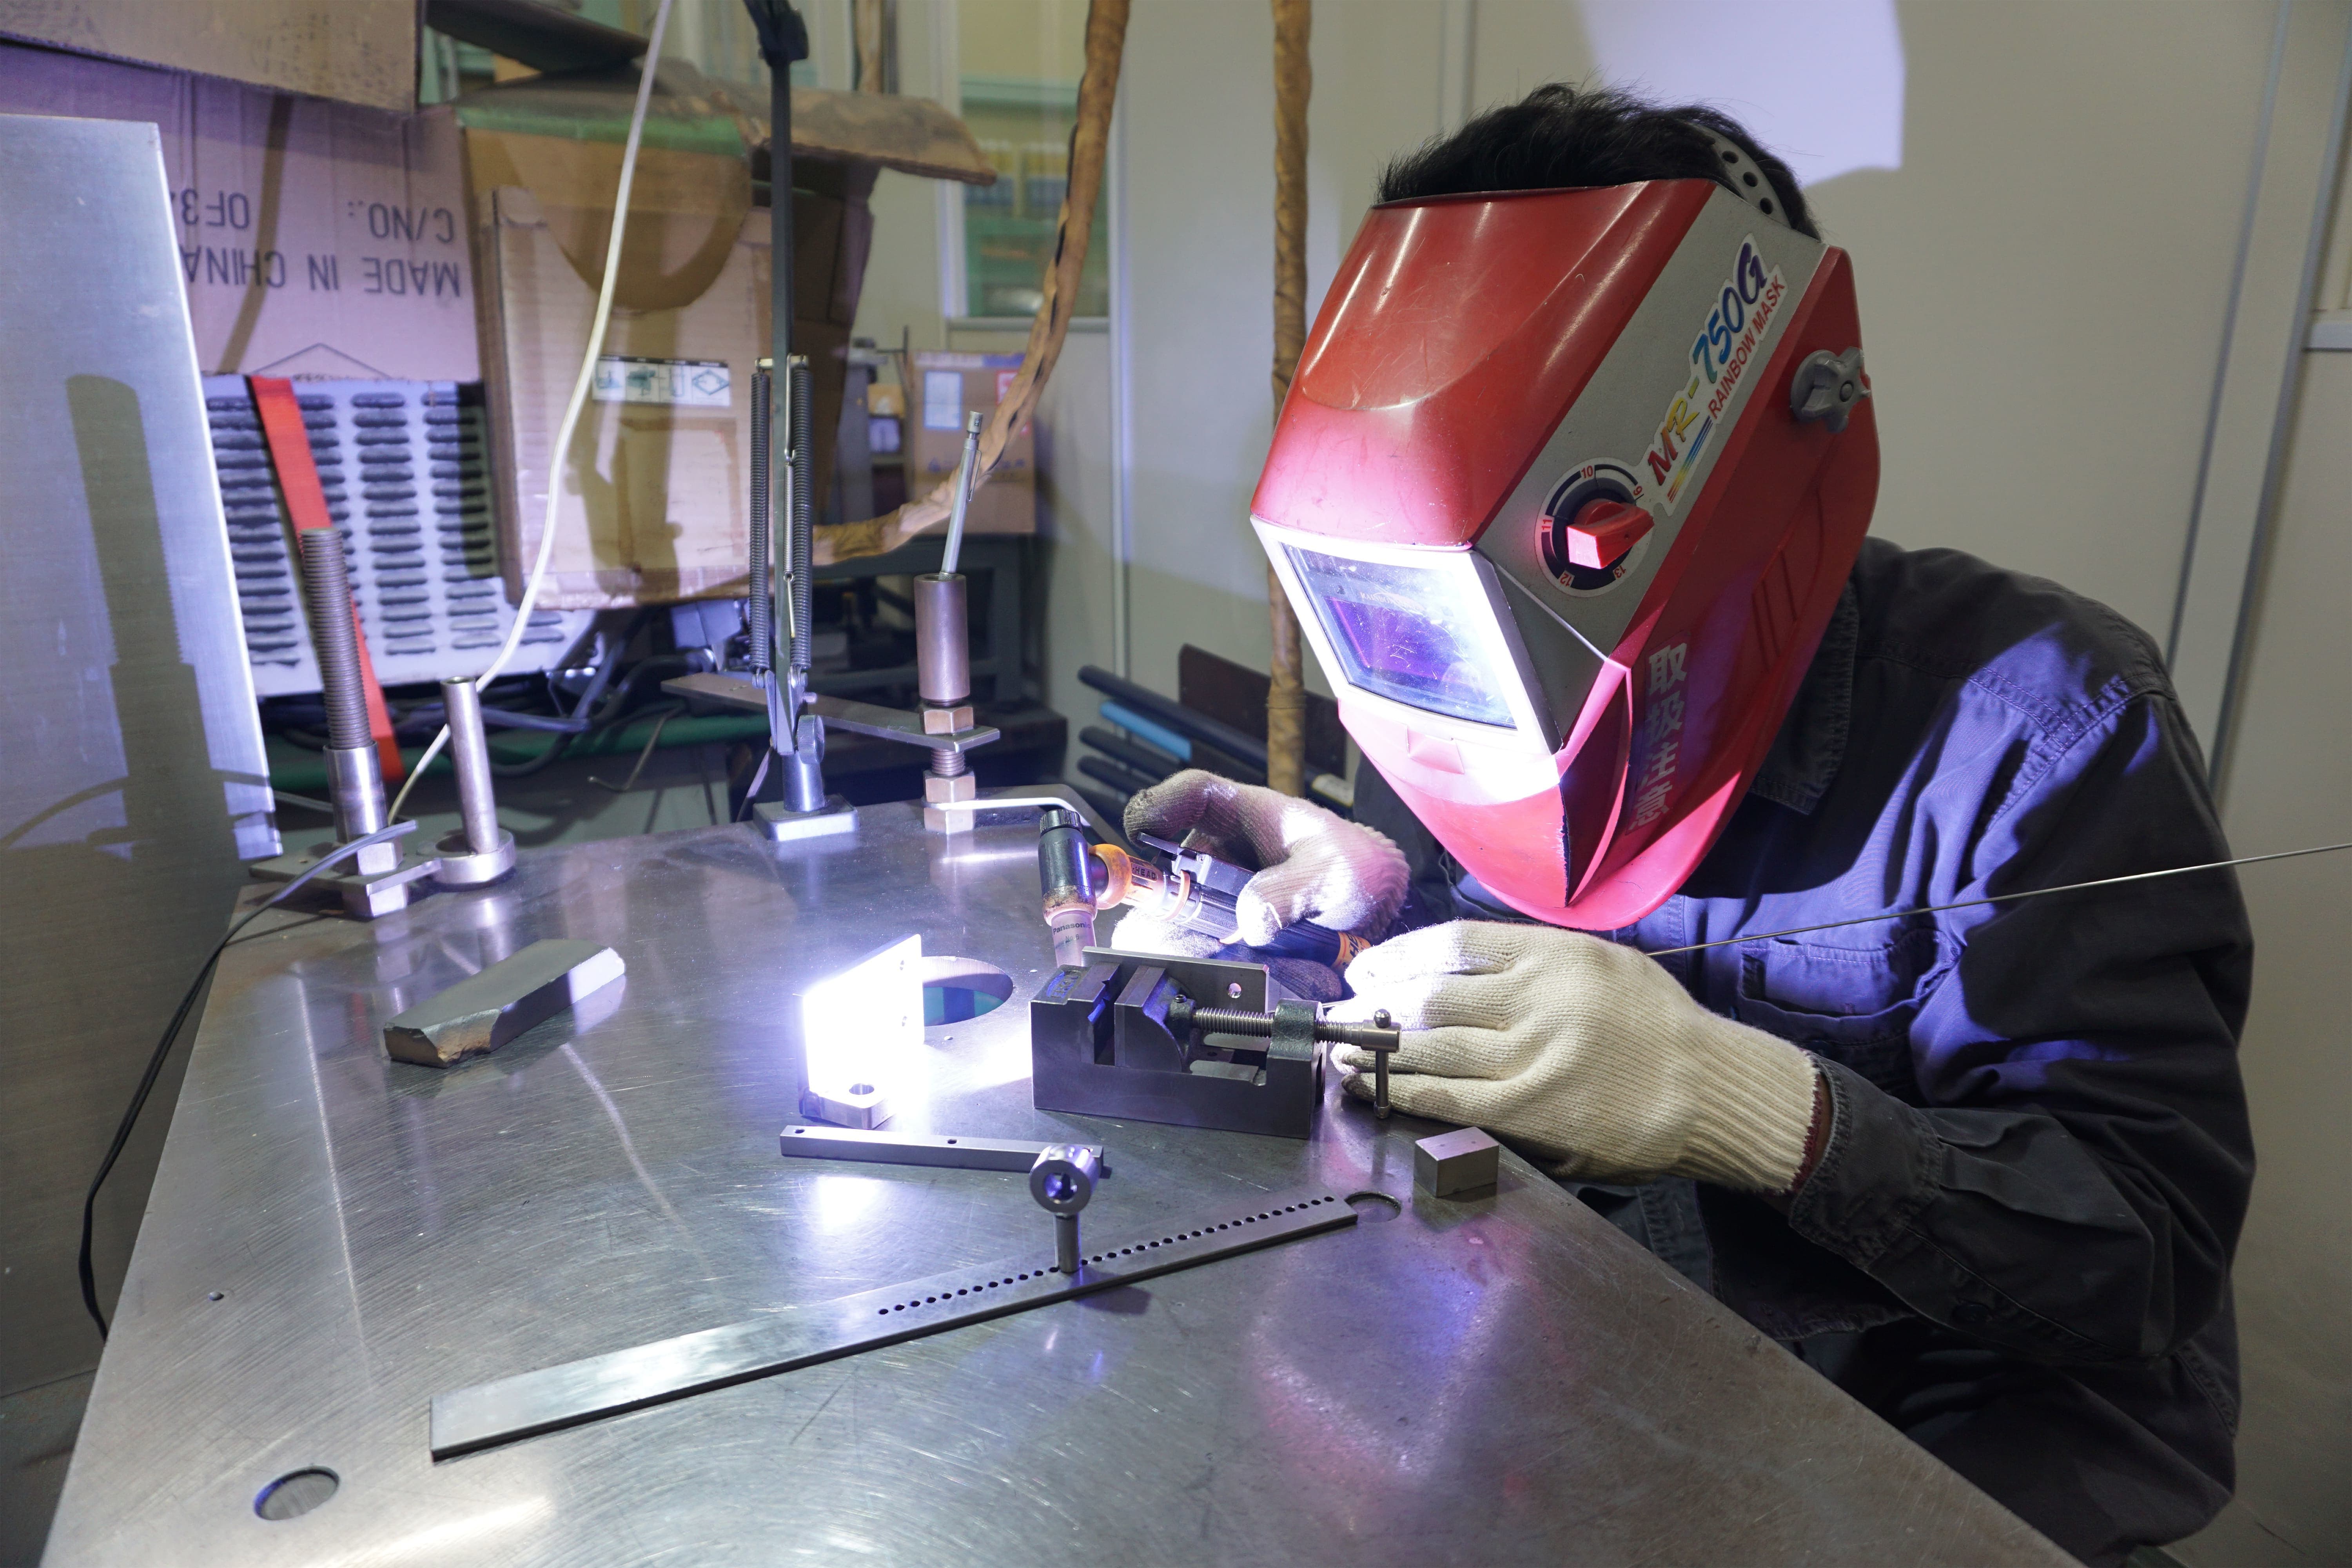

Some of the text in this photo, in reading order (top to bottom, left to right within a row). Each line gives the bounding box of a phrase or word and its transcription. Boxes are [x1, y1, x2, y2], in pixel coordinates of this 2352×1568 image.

[179, 243, 461, 298] MADE IN CHINA
[1708, 274, 1786, 419] RAINBOW MASK
[1648, 242, 1767, 486] MR-750G
[1581, 465, 1593, 479] 10
[1542, 519, 1552, 530] 11
[1614, 565, 1626, 578] 13
[1560, 573, 1572, 587] 12
[1628, 642, 1687, 830] 取扱注意
[1053, 922, 1091, 935] Panasonic
